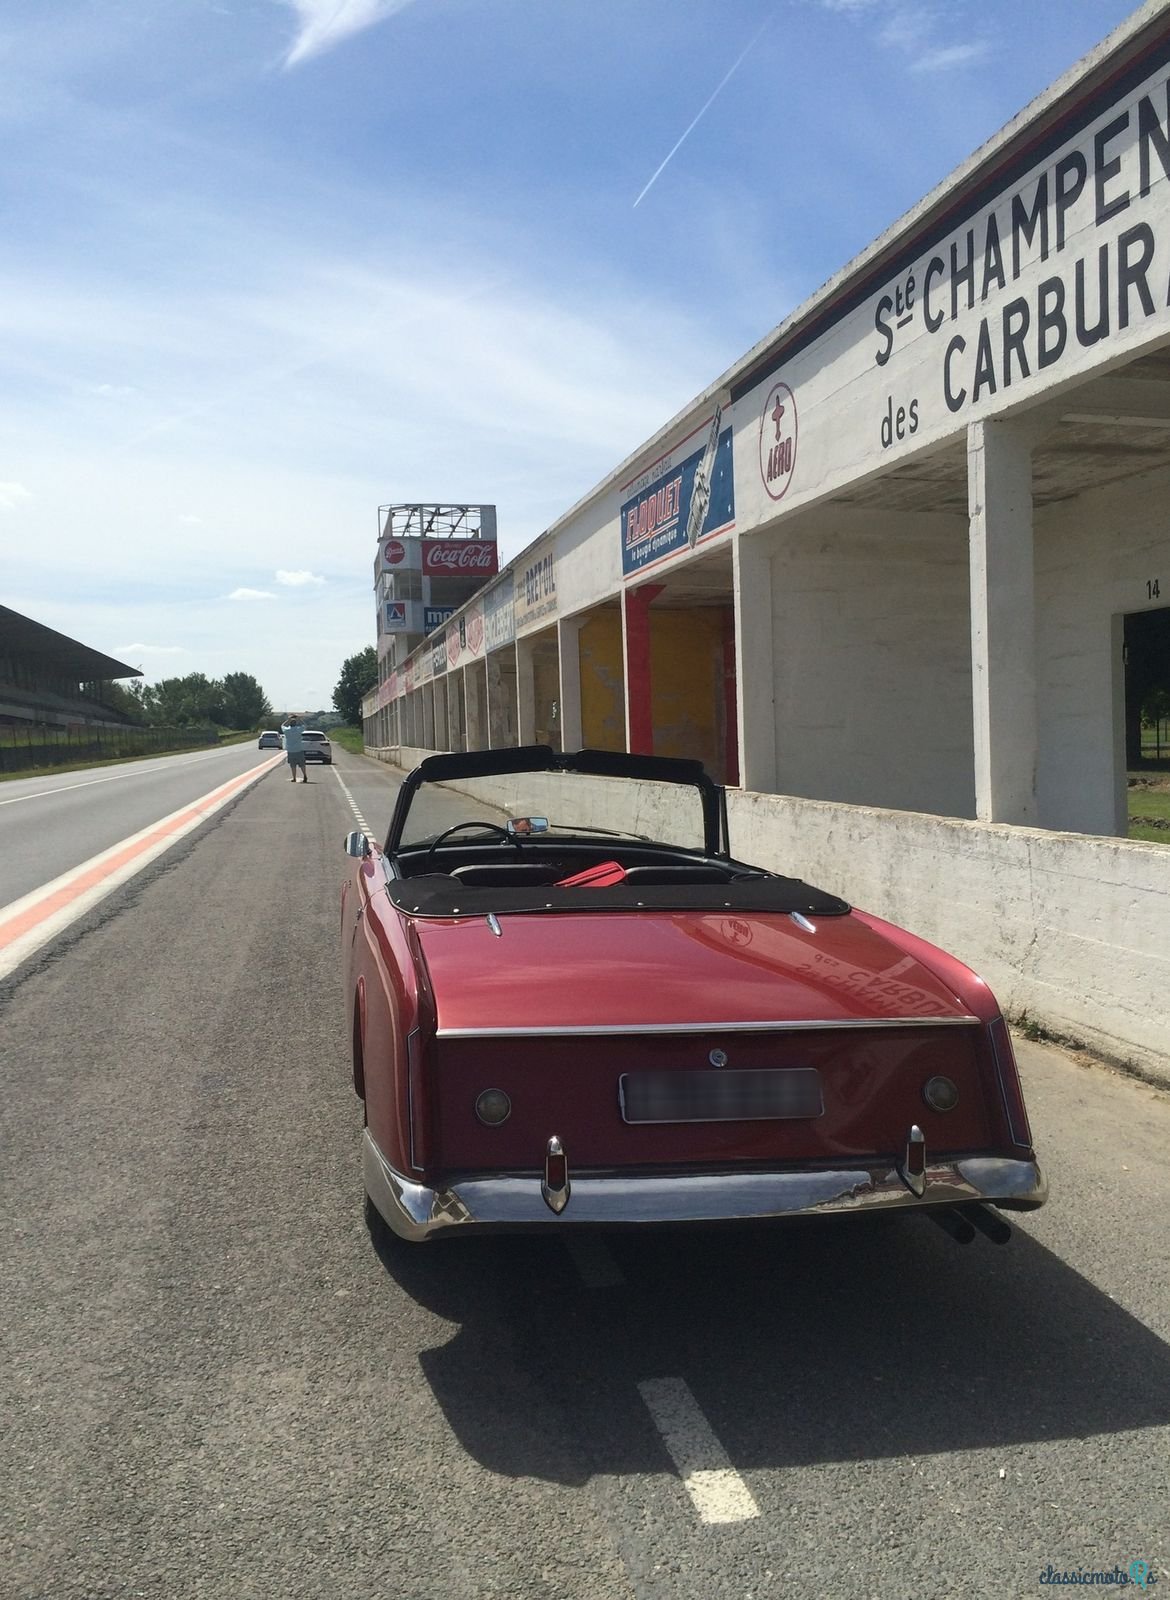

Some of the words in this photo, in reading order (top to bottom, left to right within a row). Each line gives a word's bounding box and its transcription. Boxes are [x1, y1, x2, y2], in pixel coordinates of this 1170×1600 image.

[881, 395, 919, 450] des
[943, 221, 1170, 414] CARBUR
[766, 436, 792, 484] AERO
[1146, 579, 1161, 600] 14
